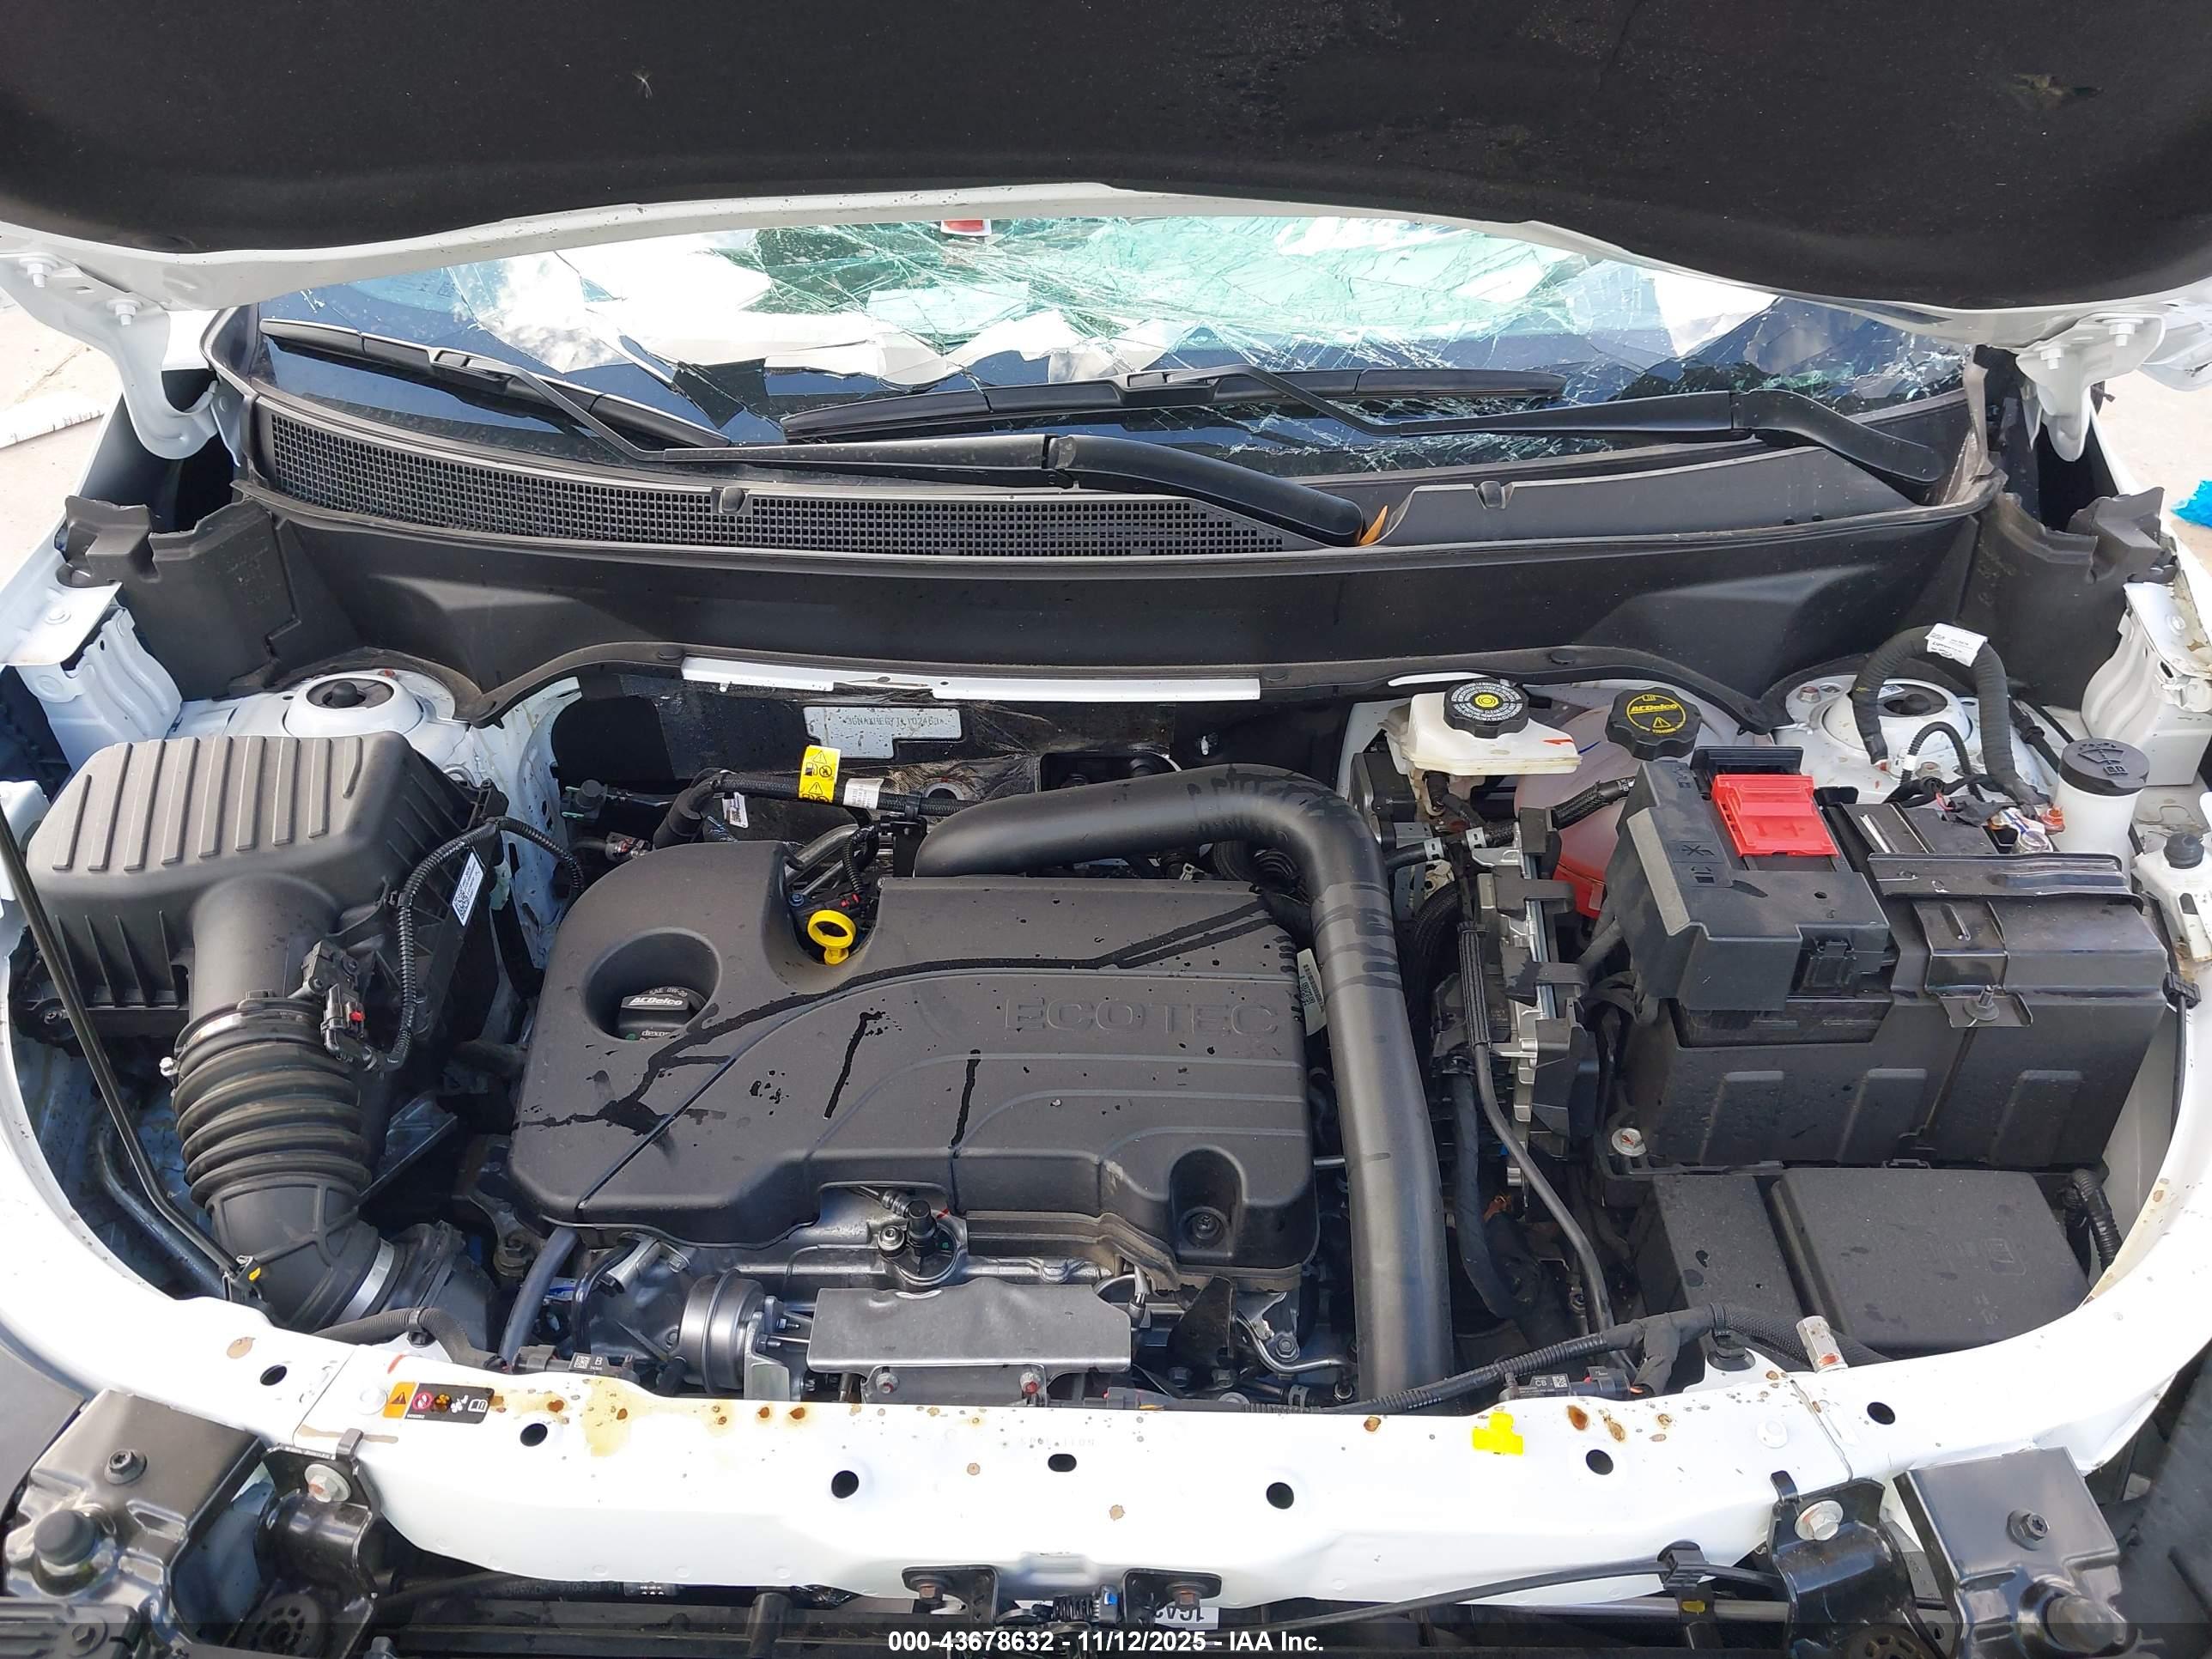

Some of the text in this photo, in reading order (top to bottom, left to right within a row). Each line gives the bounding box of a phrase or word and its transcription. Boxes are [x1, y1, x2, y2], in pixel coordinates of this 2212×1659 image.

[1630, 703, 1678, 714] ACDelco
[629, 997, 684, 1006] ACDelco
[1005, 997, 1279, 1036] ECOTEC
